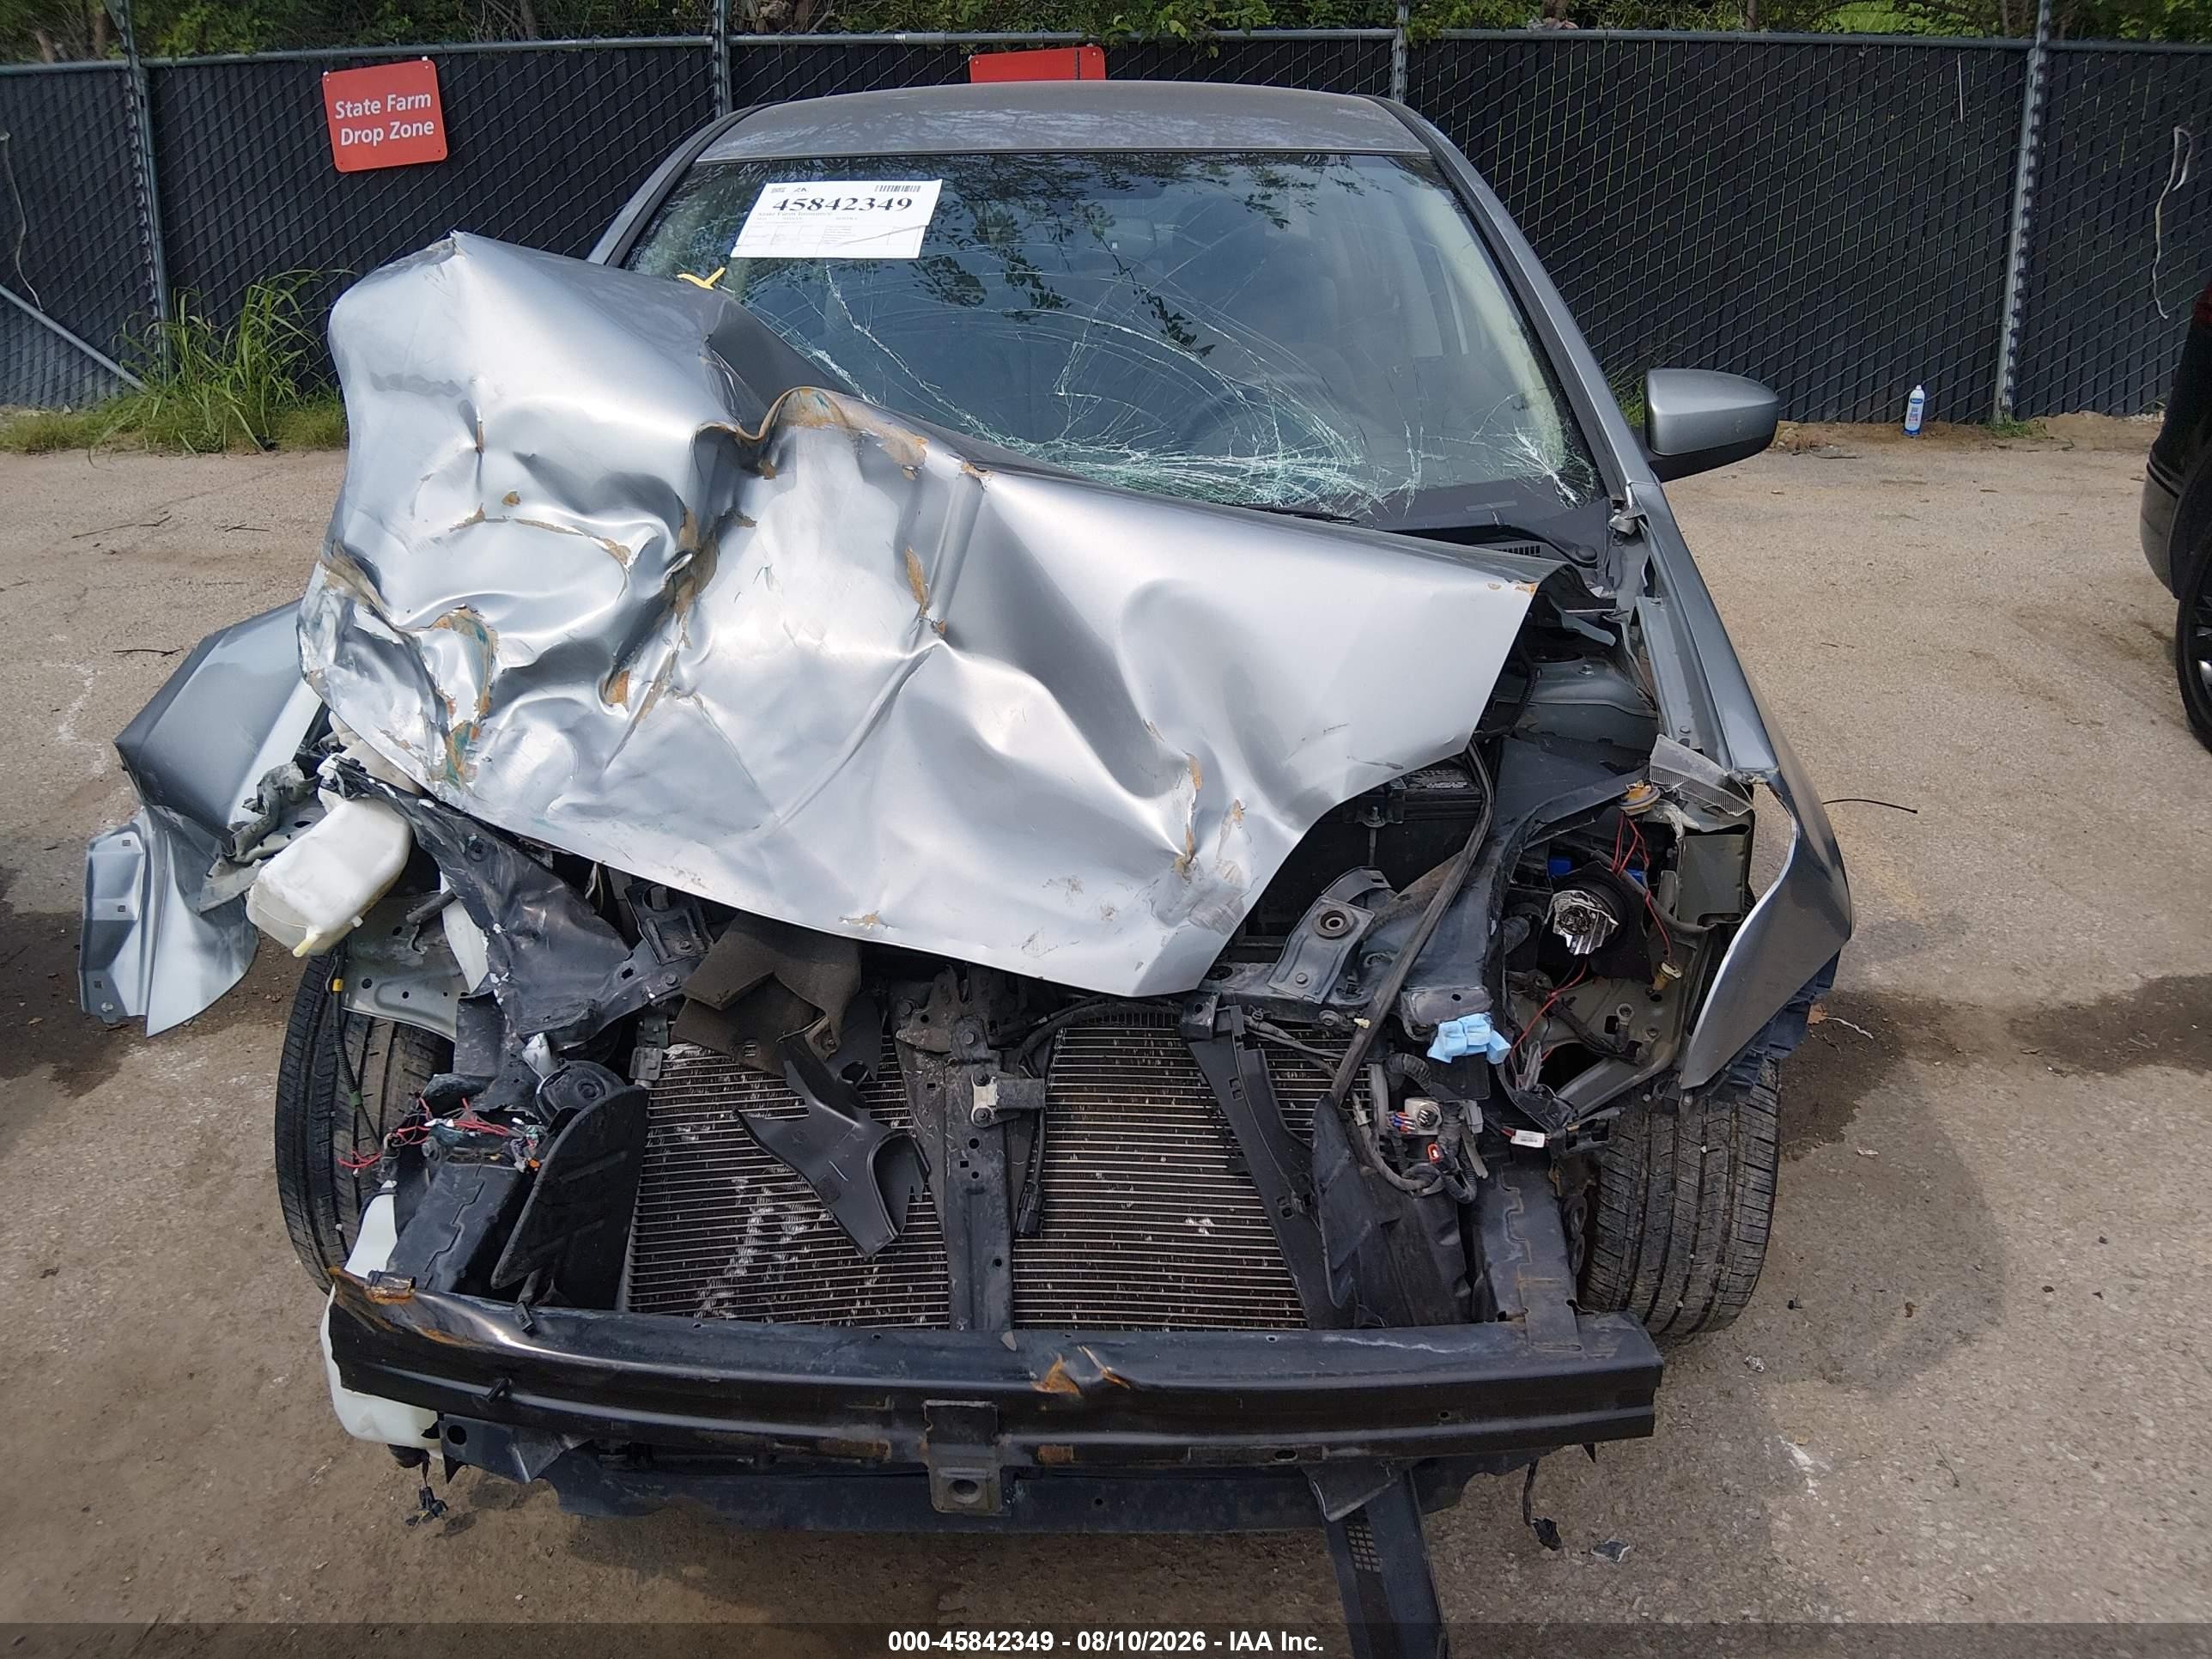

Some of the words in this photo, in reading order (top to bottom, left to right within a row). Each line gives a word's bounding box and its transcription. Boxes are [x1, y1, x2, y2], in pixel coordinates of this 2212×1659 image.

[335, 99, 381, 119] State
[387, 94, 431, 112] Farm
[341, 127, 384, 147] Drop
[389, 121, 434, 140] Zone
[772, 198, 913, 211] 45842349
